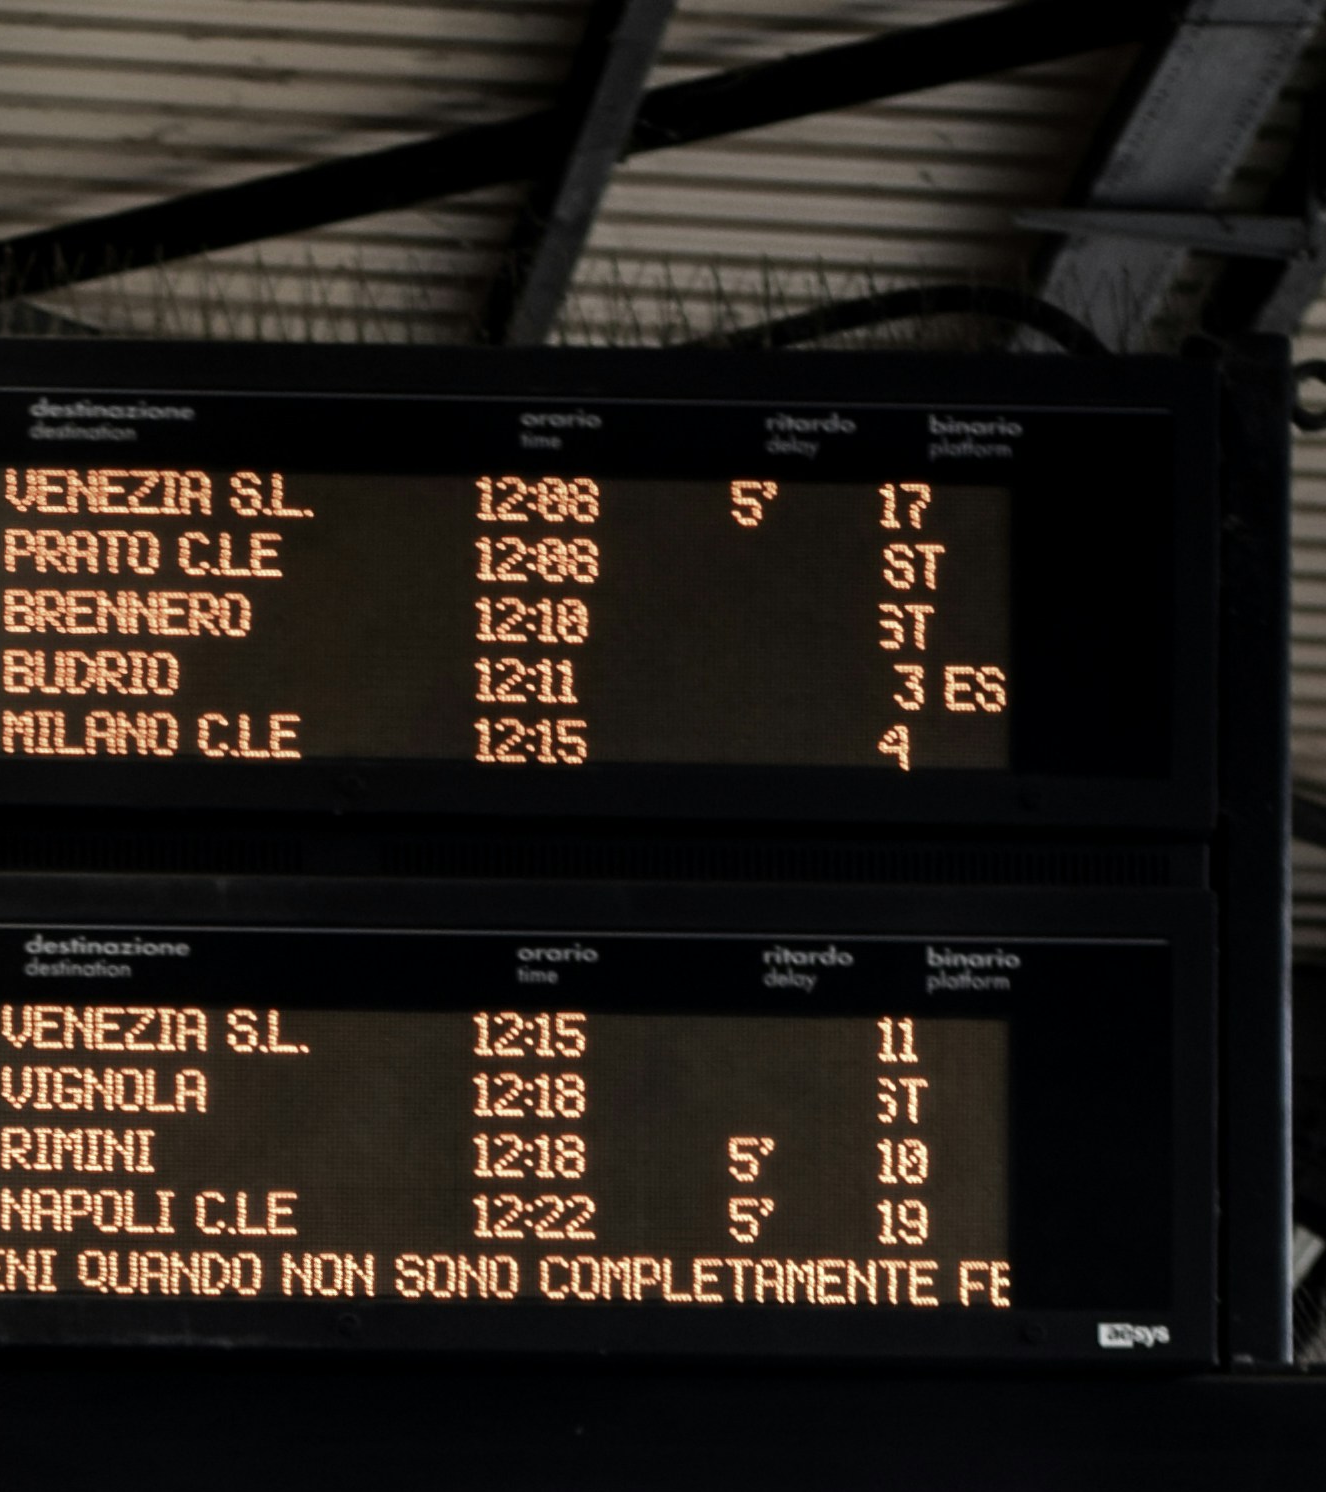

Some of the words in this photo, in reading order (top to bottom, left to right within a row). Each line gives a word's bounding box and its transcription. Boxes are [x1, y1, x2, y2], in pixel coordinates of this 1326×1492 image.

[6, 469, 213, 516] VENEZIA
[880, 484, 932, 530] 17
[5, 529, 161, 576] PRATO
[4, 590, 252, 638] BRENNERO
[4, 650, 181, 697] BUDRIO
[476, 659, 579, 705] 12:11
[895, 666, 925, 712] 3
[945, 667, 1007, 713] ES
[3, 711, 180, 757] MILANO
[476, 719, 588, 765] 12:15
[879, 726, 910, 772] 4
[24, 933, 191, 958] destinazione
[516, 943, 600, 962] orario
[762, 945, 854, 967] ritardo
[926, 946, 1021, 969] binario
[24, 957, 131, 978] destination
[516, 966, 559, 984] time
[762, 969, 817, 993] delay
[926, 972, 1011, 994] platform
[3, 1006, 208, 1053] VENEZIA
[474, 1013, 587, 1058] 12:15
[878, 1018, 919, 1064] 11
[2, 1067, 208, 1114] VIGNOLA
[474, 1074, 587, 1119] 12:18
[2, 1128, 156, 1174] RIMINI
[474, 1134, 586, 1180] 12:18
[878, 1139, 930, 1185] 10
[2, 1189, 176, 1235] NAPOLI
[474, 1195, 597, 1241] 12:22
[878, 1200, 930, 1246] 19
[79, 1251, 263, 1296] QUANDO
[283, 1254, 376, 1298] NON
[396, 1255, 520, 1300] SONO
[541, 1257, 940, 1307] COMPLETAMENTE
